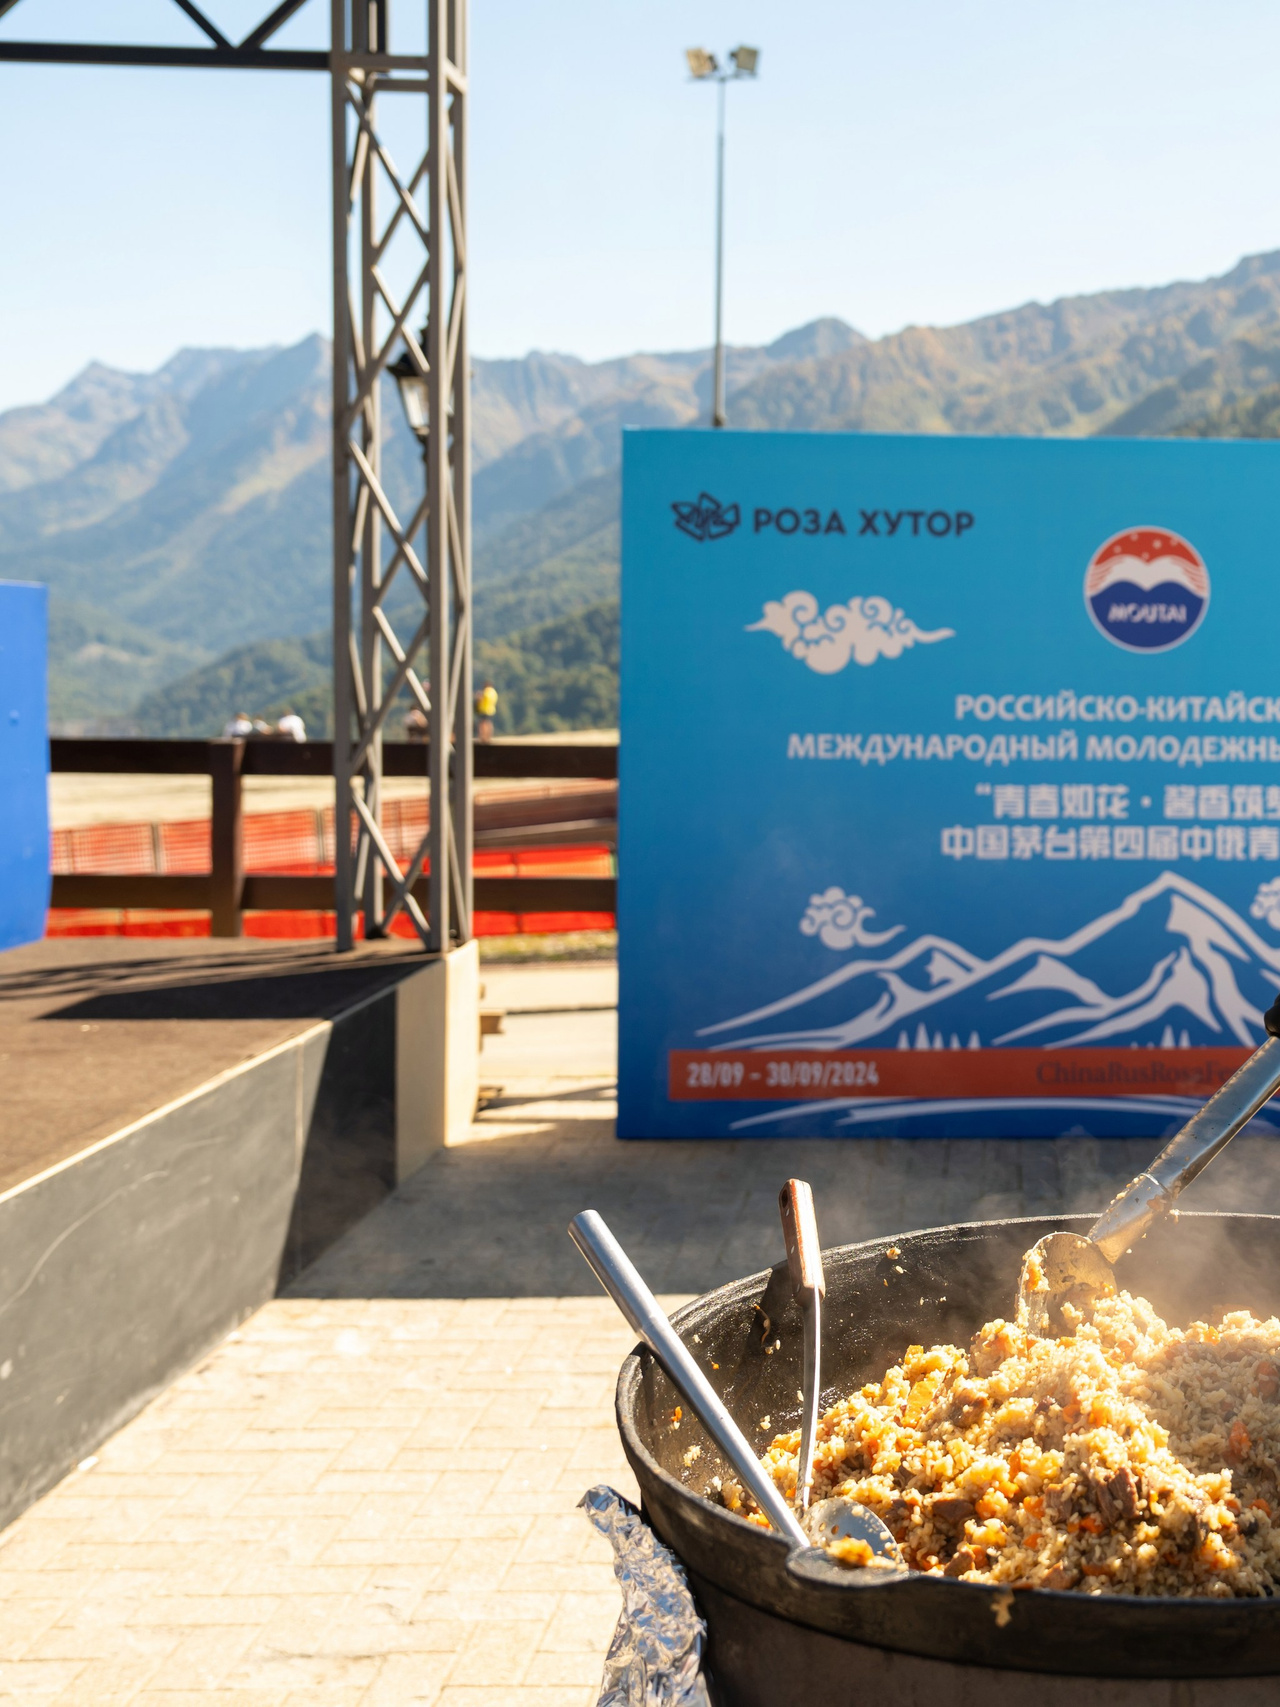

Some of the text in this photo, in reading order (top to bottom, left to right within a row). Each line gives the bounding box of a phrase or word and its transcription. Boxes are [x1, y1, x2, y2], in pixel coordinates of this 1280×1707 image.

[753, 507, 976, 538] РОЗА ХУТОР
[1108, 602, 1188, 624] MOUTAI
[787, 730, 1079, 767] МЕЖДУНАРОДНЫЙ
[687, 1061, 745, 1088] 28/09
[766, 1060, 880, 1087] 30/09/2024
